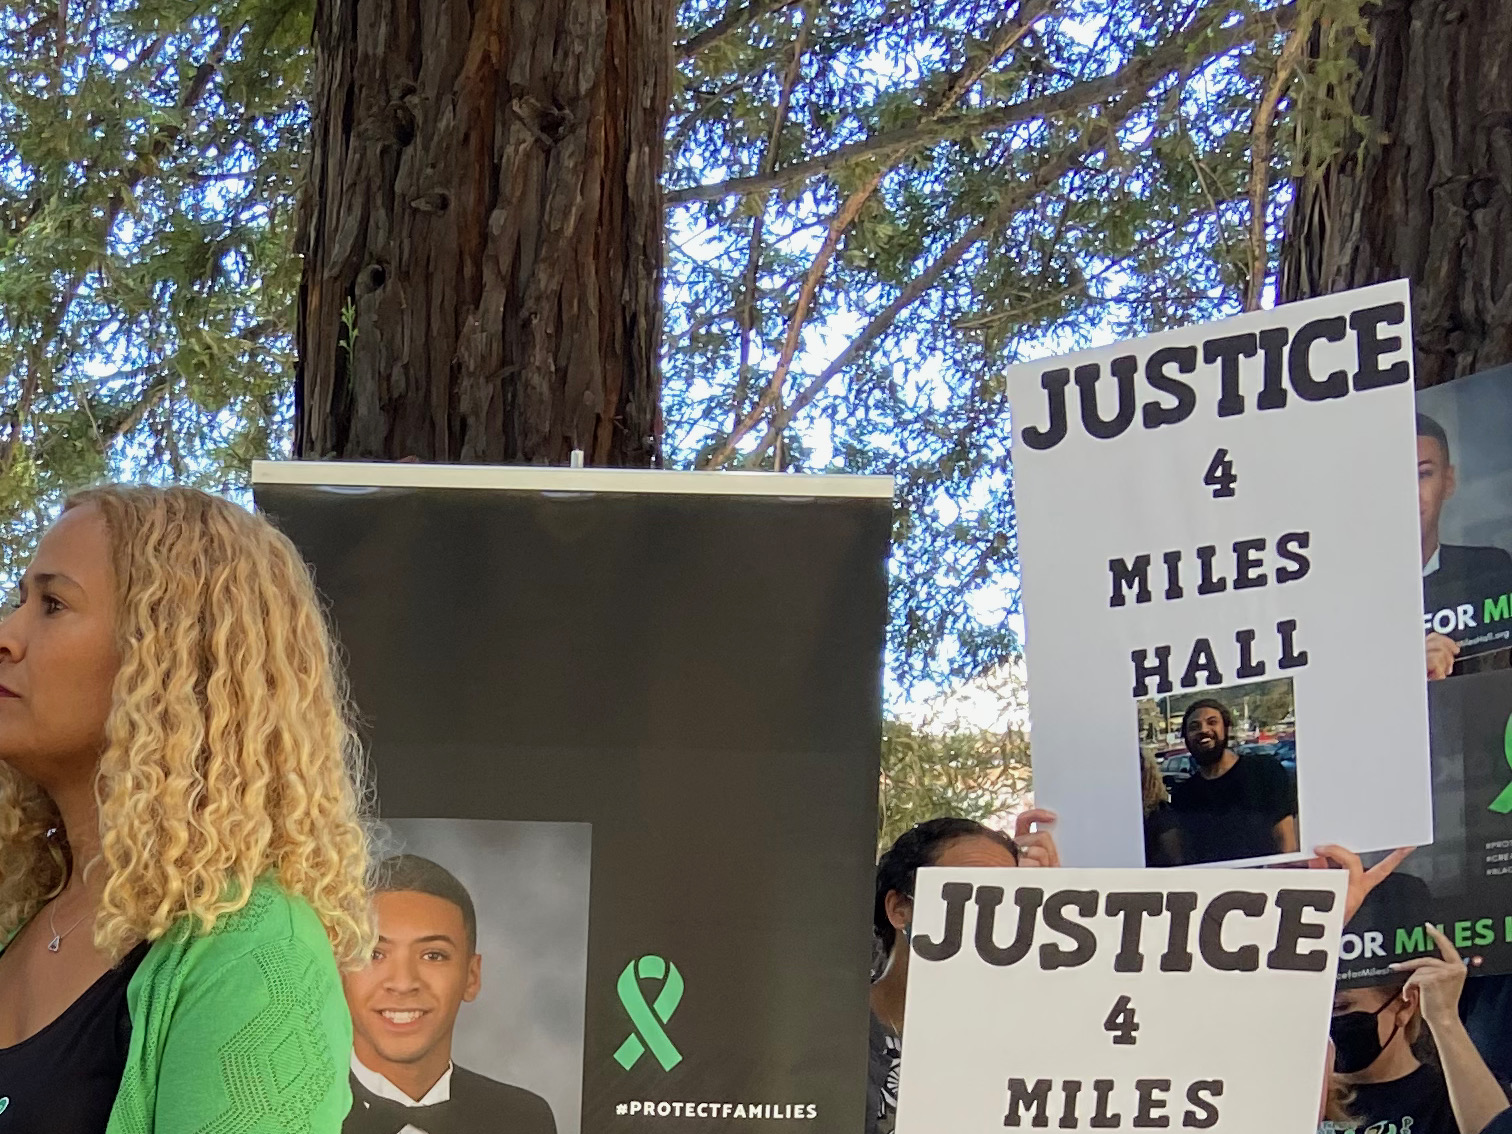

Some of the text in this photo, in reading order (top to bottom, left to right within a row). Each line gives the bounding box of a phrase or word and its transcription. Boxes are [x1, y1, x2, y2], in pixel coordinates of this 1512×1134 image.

[1021, 301, 1411, 451] JUSTICE
[1203, 447, 1238, 499] 4
[1108, 531, 1311, 607] MILES
[1132, 618, 1308, 697] HALL
[911, 882, 1335, 972] JUSTICE
[1395, 918, 1495, 955] MIES
[1104, 995, 1140, 1045] 4
[615, 1100, 818, 1120] #PROTECTFAMILIES
[1004, 1077, 1224, 1129] MILES
